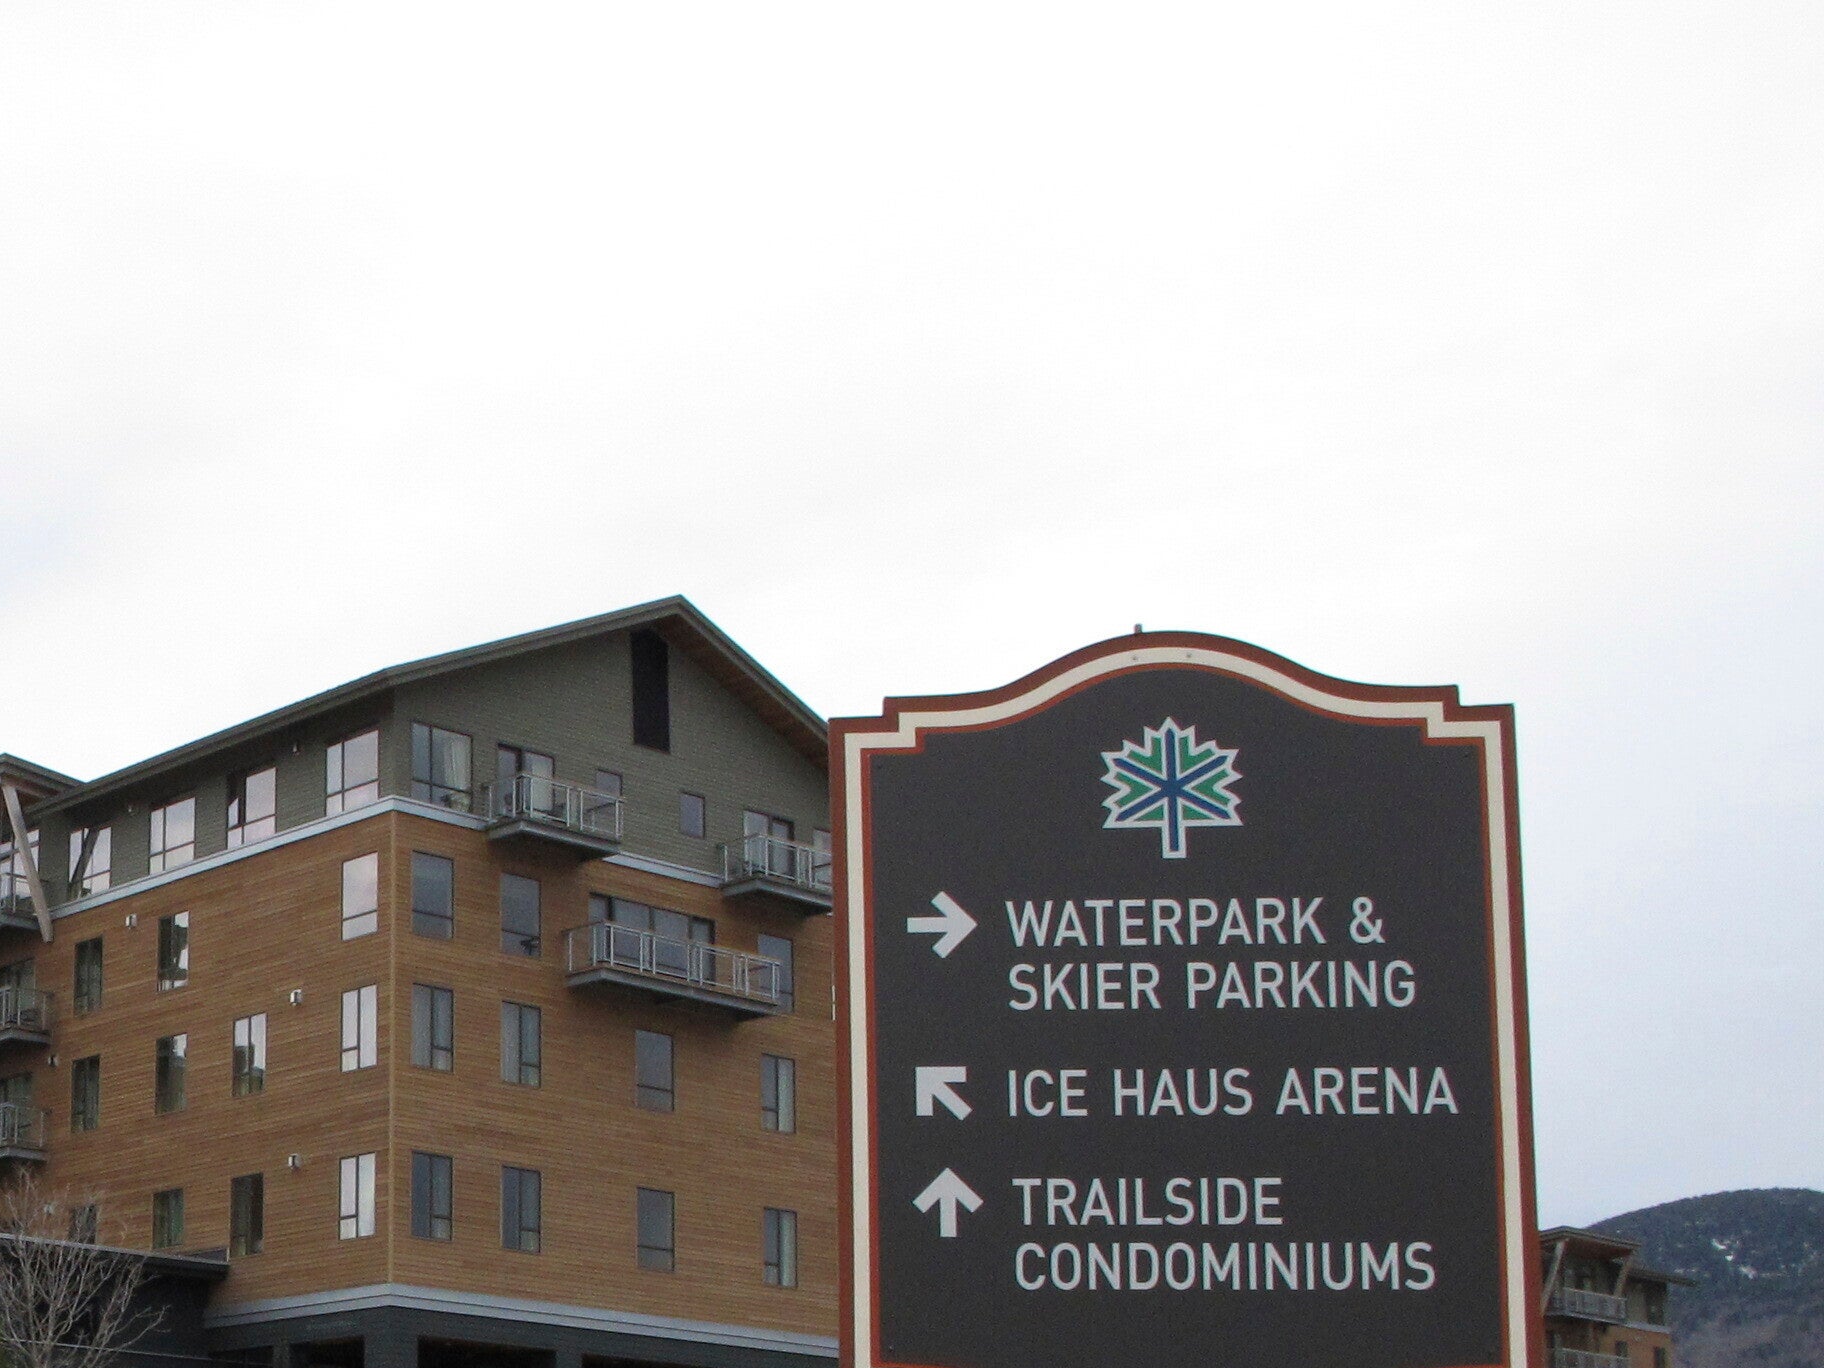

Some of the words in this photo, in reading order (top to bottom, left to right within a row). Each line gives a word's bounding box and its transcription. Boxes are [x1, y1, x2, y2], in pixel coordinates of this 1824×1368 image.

[1005, 896, 1326, 948] WATERPARK
[1349, 896, 1386, 944] &
[1008, 961, 1162, 1011] SKIER
[1186, 959, 1416, 1009] PARKING
[1008, 1068, 1089, 1117] ICE
[1113, 1067, 1253, 1116] HAUS
[1275, 1066, 1459, 1115] ARENA
[1011, 1177, 1283, 1226] TRAILSIDE
[1015, 1241, 1436, 1291] CONDOMINIUMS
